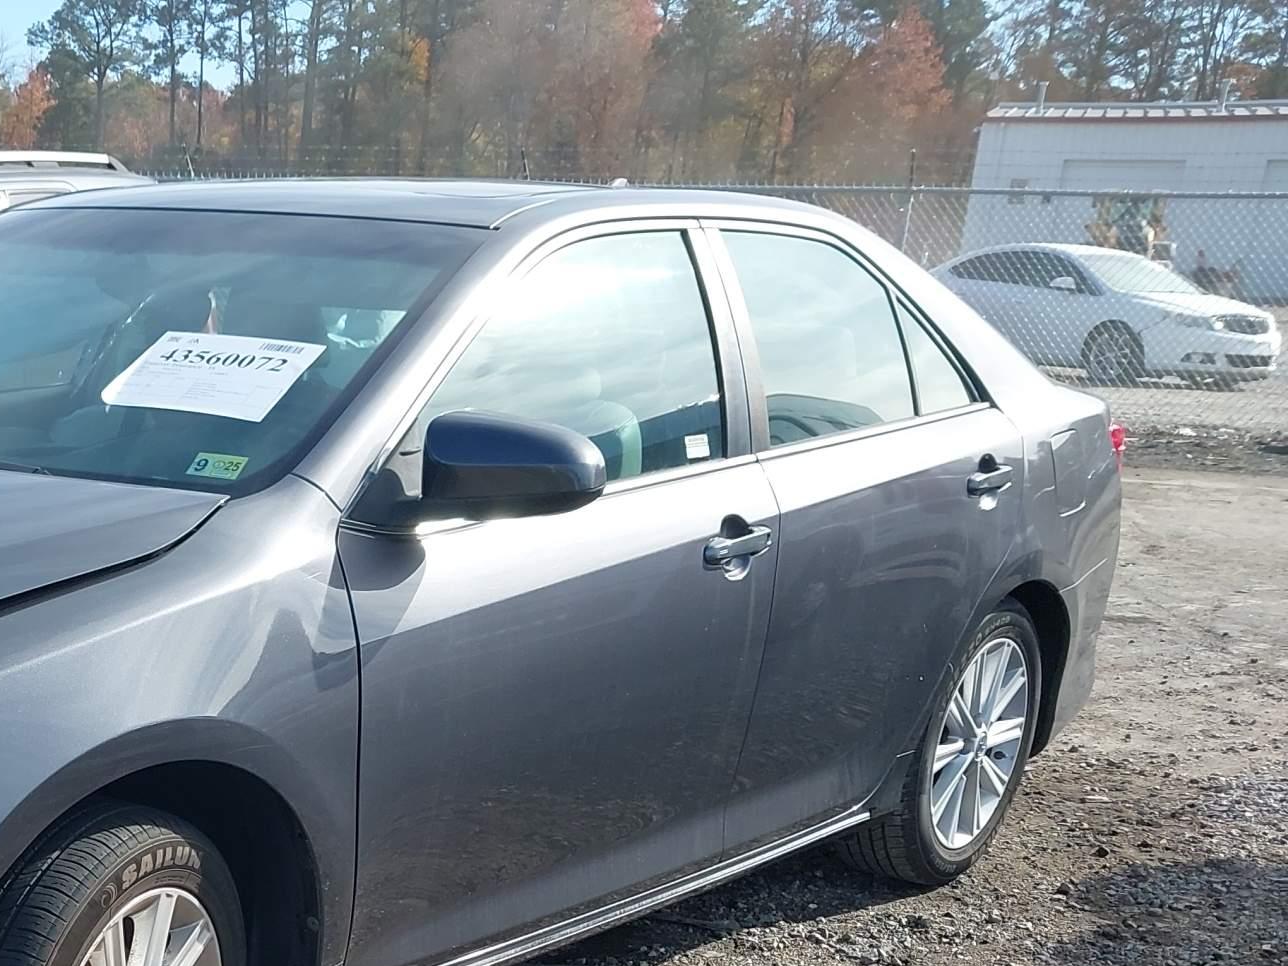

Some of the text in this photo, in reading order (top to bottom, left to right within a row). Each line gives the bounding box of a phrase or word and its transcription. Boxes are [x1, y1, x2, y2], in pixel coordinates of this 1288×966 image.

[160, 349, 288, 372] 43560072
[195, 458, 241, 471] 9 25
[122, 848, 200, 890] SAILUN
